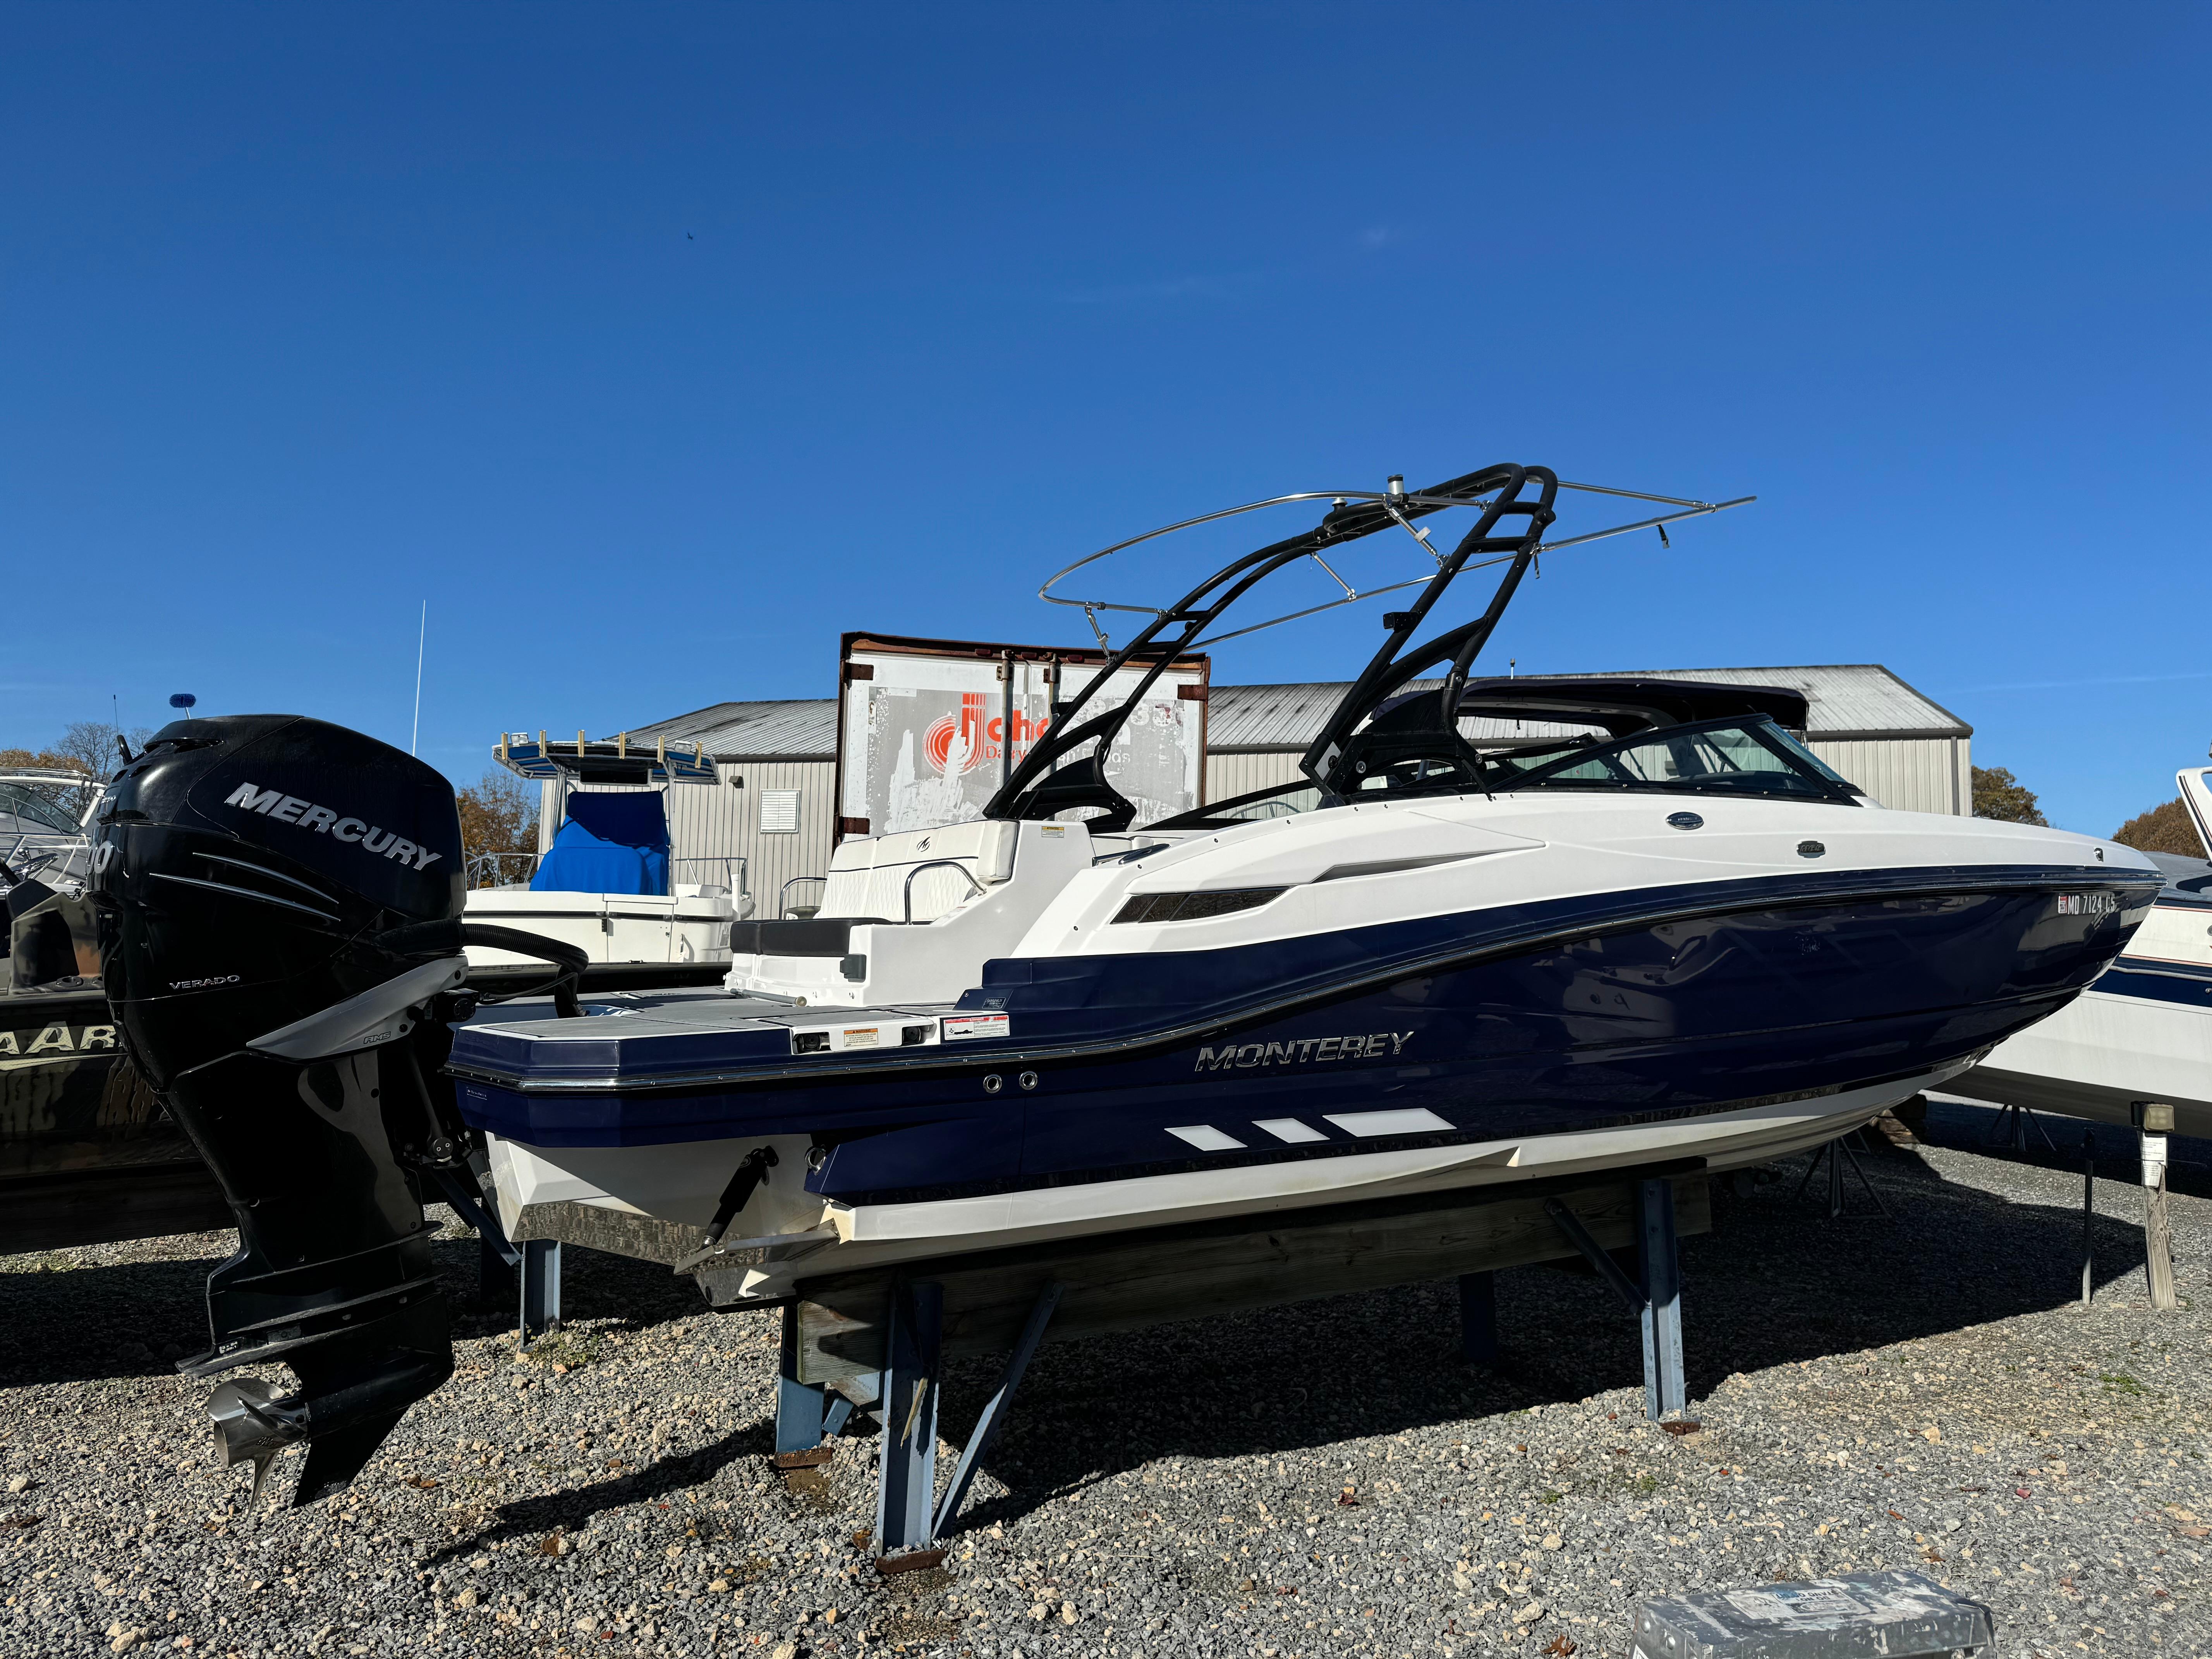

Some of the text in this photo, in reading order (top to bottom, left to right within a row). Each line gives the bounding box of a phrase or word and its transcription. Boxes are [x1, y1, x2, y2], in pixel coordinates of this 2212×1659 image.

[225, 782, 442, 871] MERCURY
[86, 840, 114, 874] 00
[2068, 895, 2080, 915] MD
[2083, 895, 2102, 914] 7124
[169, 975, 240, 990] VERADO
[364, 1031, 391, 1044] AMS
[1195, 1031, 1414, 1072] MONTEREY
